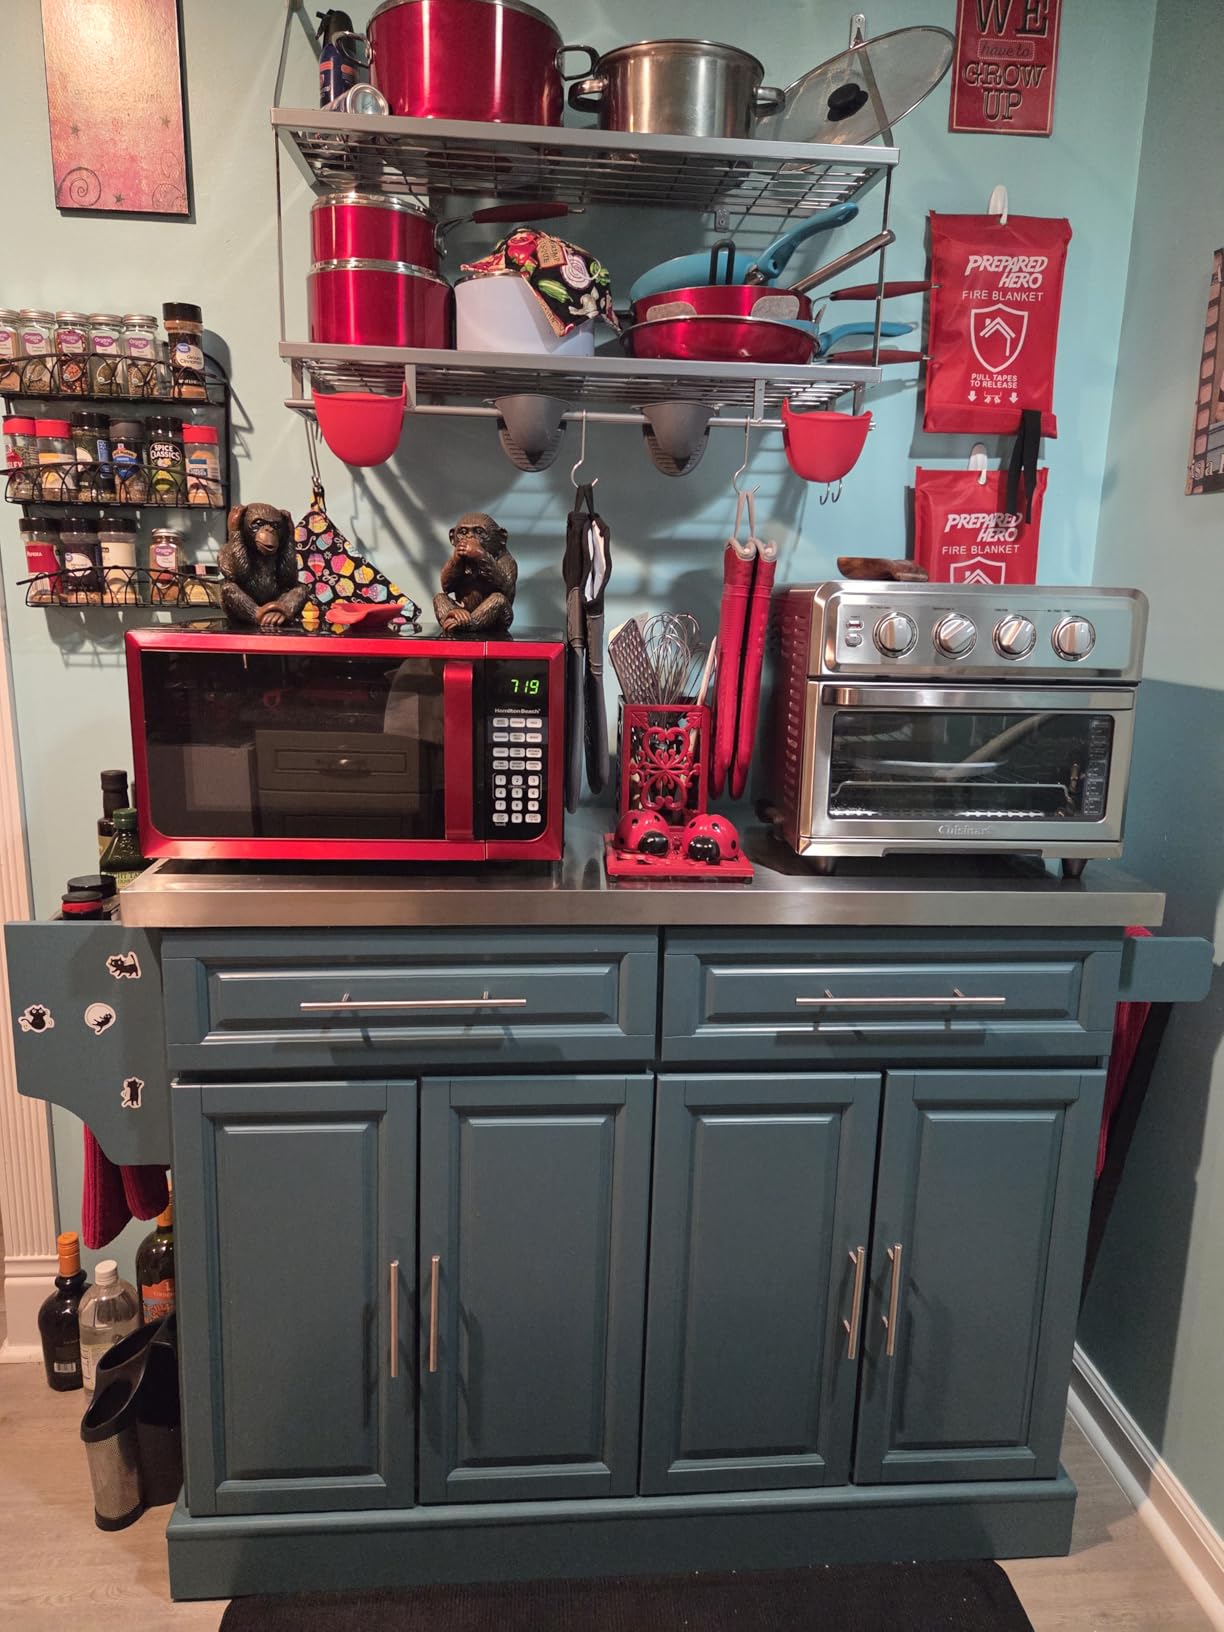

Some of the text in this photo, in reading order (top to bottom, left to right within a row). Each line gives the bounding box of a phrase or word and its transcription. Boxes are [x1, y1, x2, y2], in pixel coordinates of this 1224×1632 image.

[976, 0, 1050, 38] WE
[982, 42, 1031, 57] have to
[963, 61, 1047, 89] GROW
[982, 87, 1023, 122] UP
[964, 255, 1049, 276] PREPARED
[998, 272, 1043, 289] HERO
[962, 290, 1044, 302] FIRE BLANKET
[971, 373, 1018, 382] PULL TAPES
[982, 381, 1018, 389] RELEASE
[150, 450, 181, 461] CLASSICS
[154, 444, 174, 452] SPICE
[944, 512, 1024, 533] PREPARED
[976, 527, 1018, 543] HERO
[942, 544, 1020, 555] FIRE BLANKET
[511, 679, 540, 694] 719
